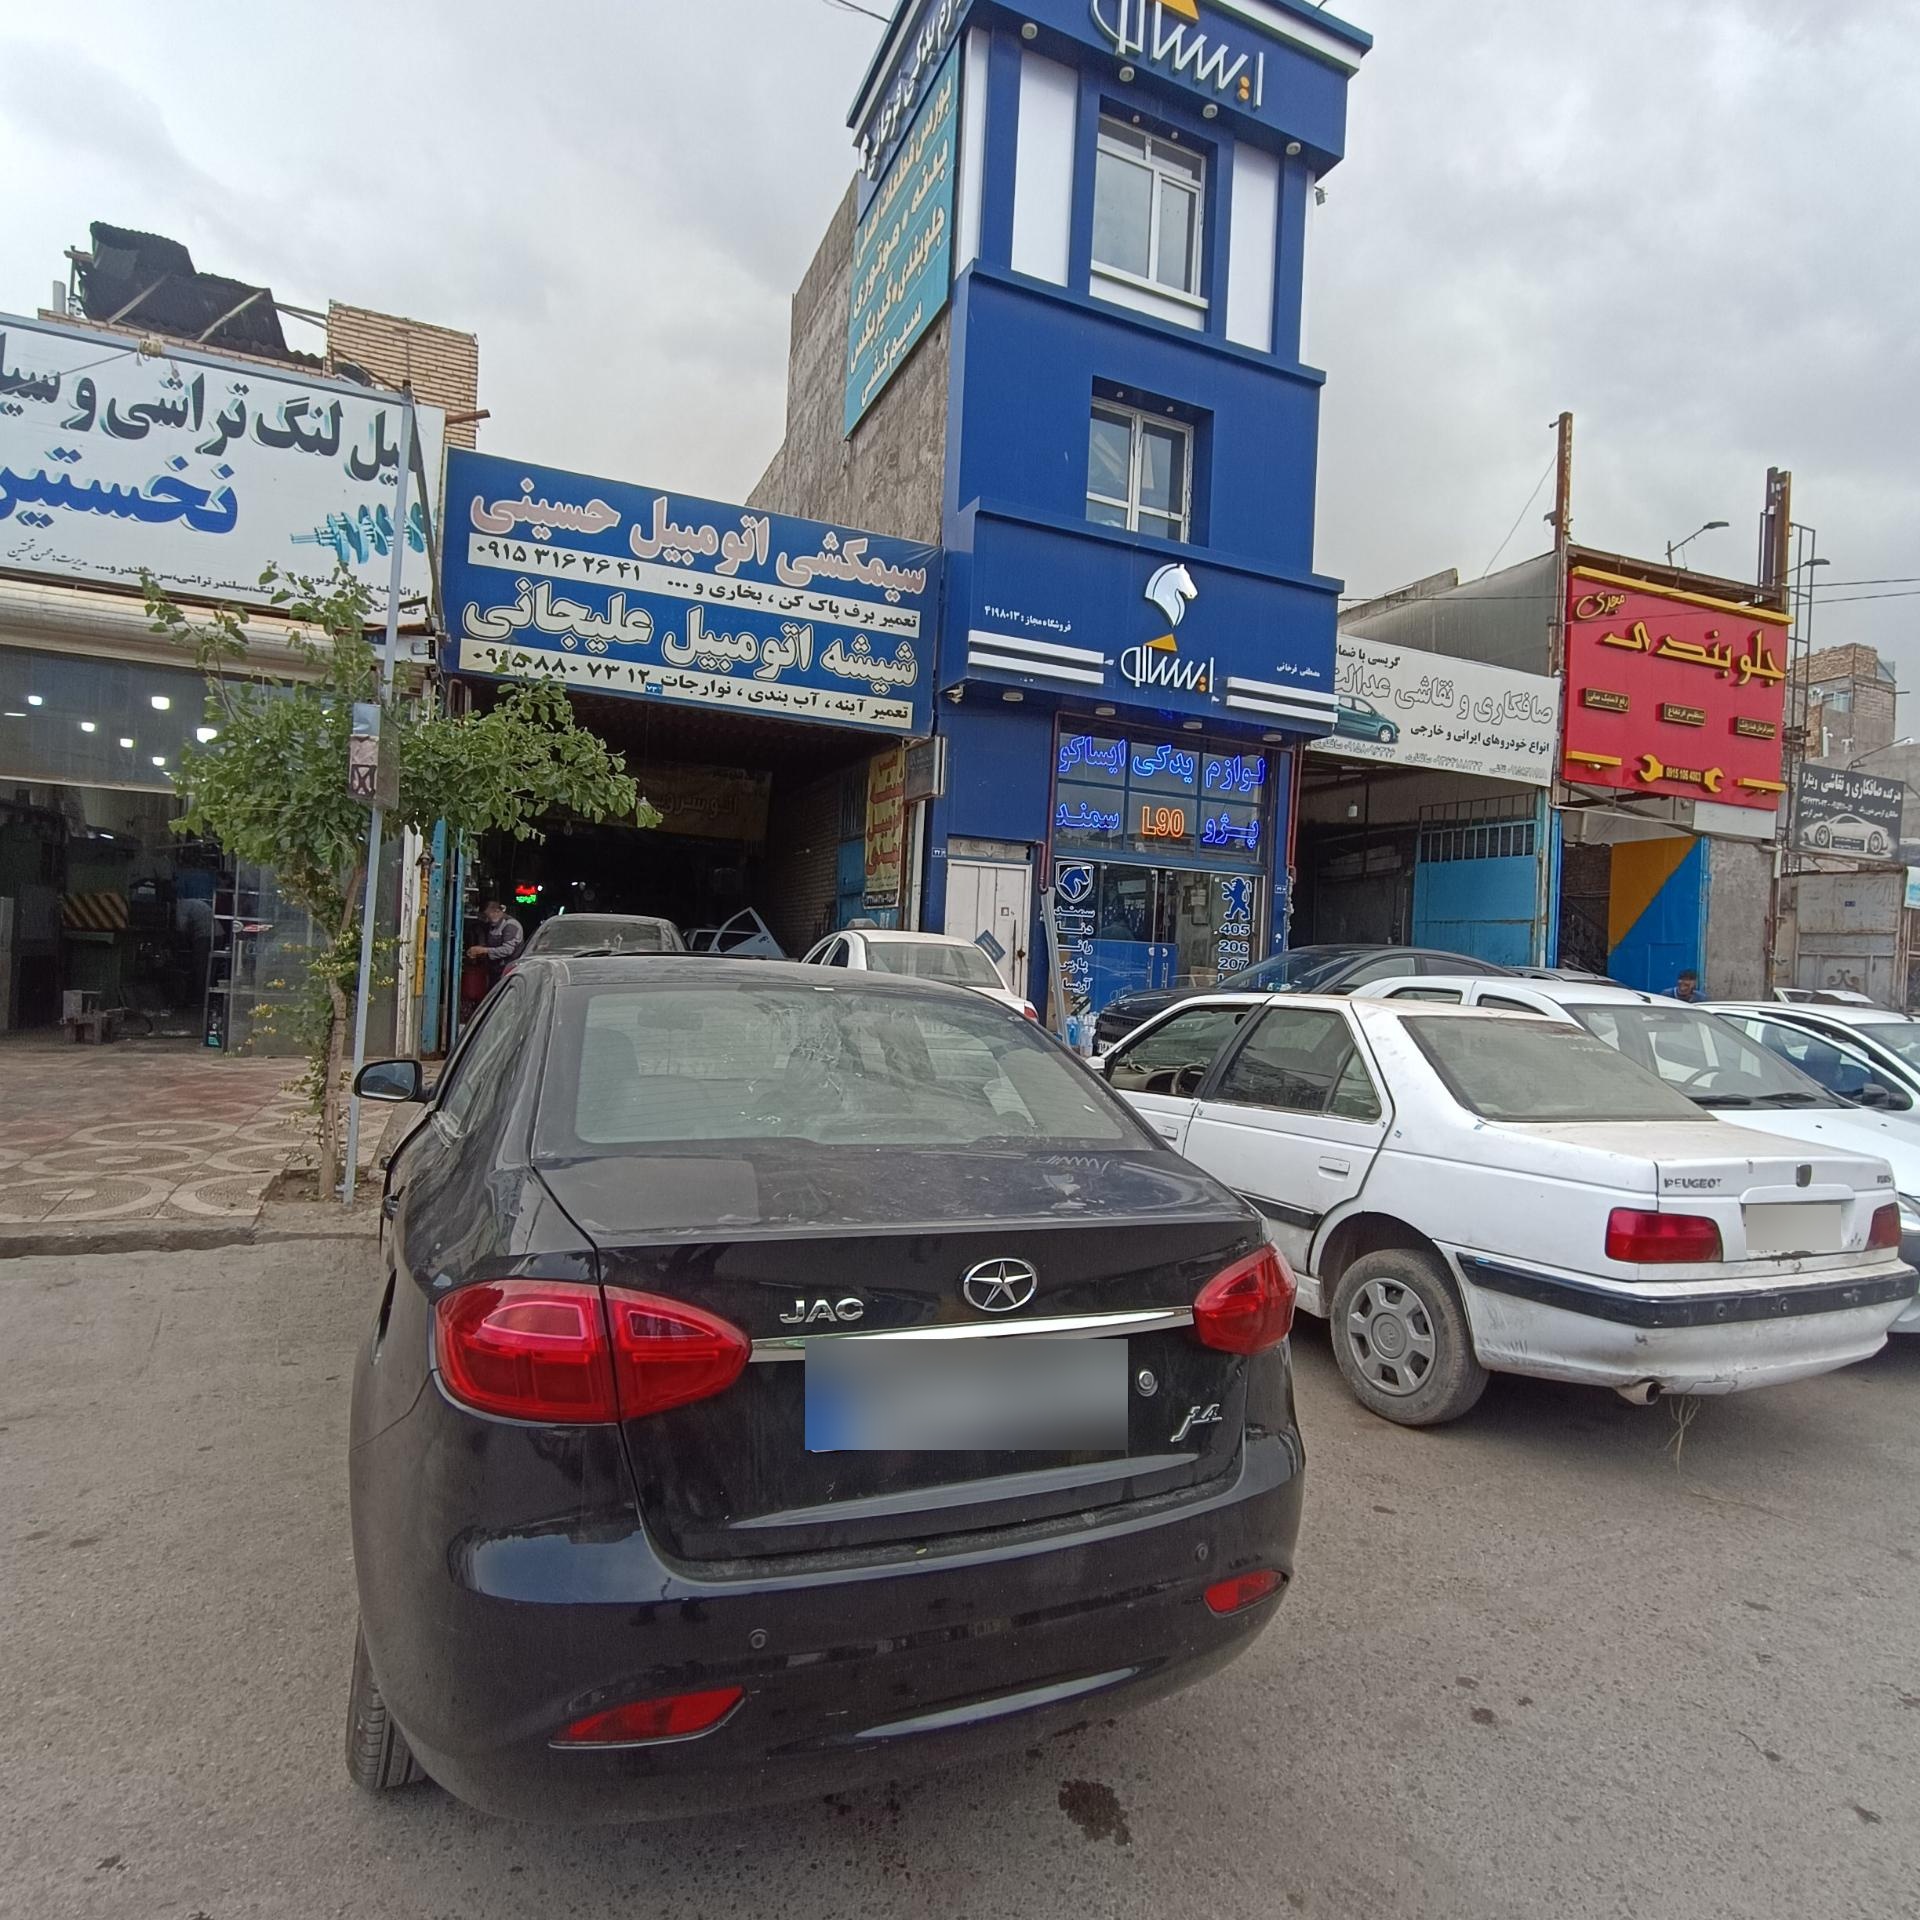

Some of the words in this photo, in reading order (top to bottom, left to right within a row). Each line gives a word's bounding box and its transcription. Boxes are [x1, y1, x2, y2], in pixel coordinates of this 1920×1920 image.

[60, 377, 96, 431] و
[106, 372, 249, 456] تراشی
[255, 397, 344, 457] لنگ
[350, 410, 423, 486] یل
[470, 478, 621, 539] حسینی
[628, 497, 770, 576] اتومبیل
[477, 540, 527, 563] ۰۹۱۵
[534, 548, 576, 569] ۳۱۶
[583, 556, 610, 574] ۲۶
[617, 562, 640, 581] ۴۱
[708, 585, 763, 605] بخاری
[462, 577, 654, 653] علیجانی
[808, 599, 840, 619] پاک
[844, 604, 875, 624] برف
[879, 614, 917, 628] تعمیر
[1043, 618, 1072, 632] فروشگاه
[661, 604, 813, 681] اتومبیل
[1336, 644, 1356, 658] ضما
[473, 647, 528, 668] ۰۹۵
[586, 662, 620, 680] ۷۳
[628, 668, 650, 684] ۱۲
[821, 634, 918, 695] شیشه
[748, 689, 788, 709] بندی
[793, 692, 820, 709] آب
[1395, 675, 1453, 709] نقاشی
[870, 706, 908, 720] تعمیر
[1456, 694, 1470, 720] و
[1473, 690, 1553, 726] صافکاری
[1410, 724, 1444, 737] خارجی
[1453, 728, 1481, 744] ایرانی
[1058, 736, 1127, 774] ایساکو
[1528, 742, 1550, 755] انواع
[1132, 745, 1194, 784] یدکی
[1205, 755, 1266, 792] لوازم
[1820, 773, 1845, 793] نقاشی
[1851, 778, 1882, 799] صافکاری
[1056, 802, 1119, 830] سمند
[1141, 805, 1185, 838] L90
[1203, 812, 1260, 848] پژو
[1054, 905, 1096, 918] سمند
[1056, 920, 1094, 935] دنا
[1219, 922, 1251, 936] 405
[1057, 939, 1094, 955] ران
[1218, 940, 1249, 953] 206
[1218, 958, 1249, 971] 207
[779, 1297, 865, 1324] JAC
